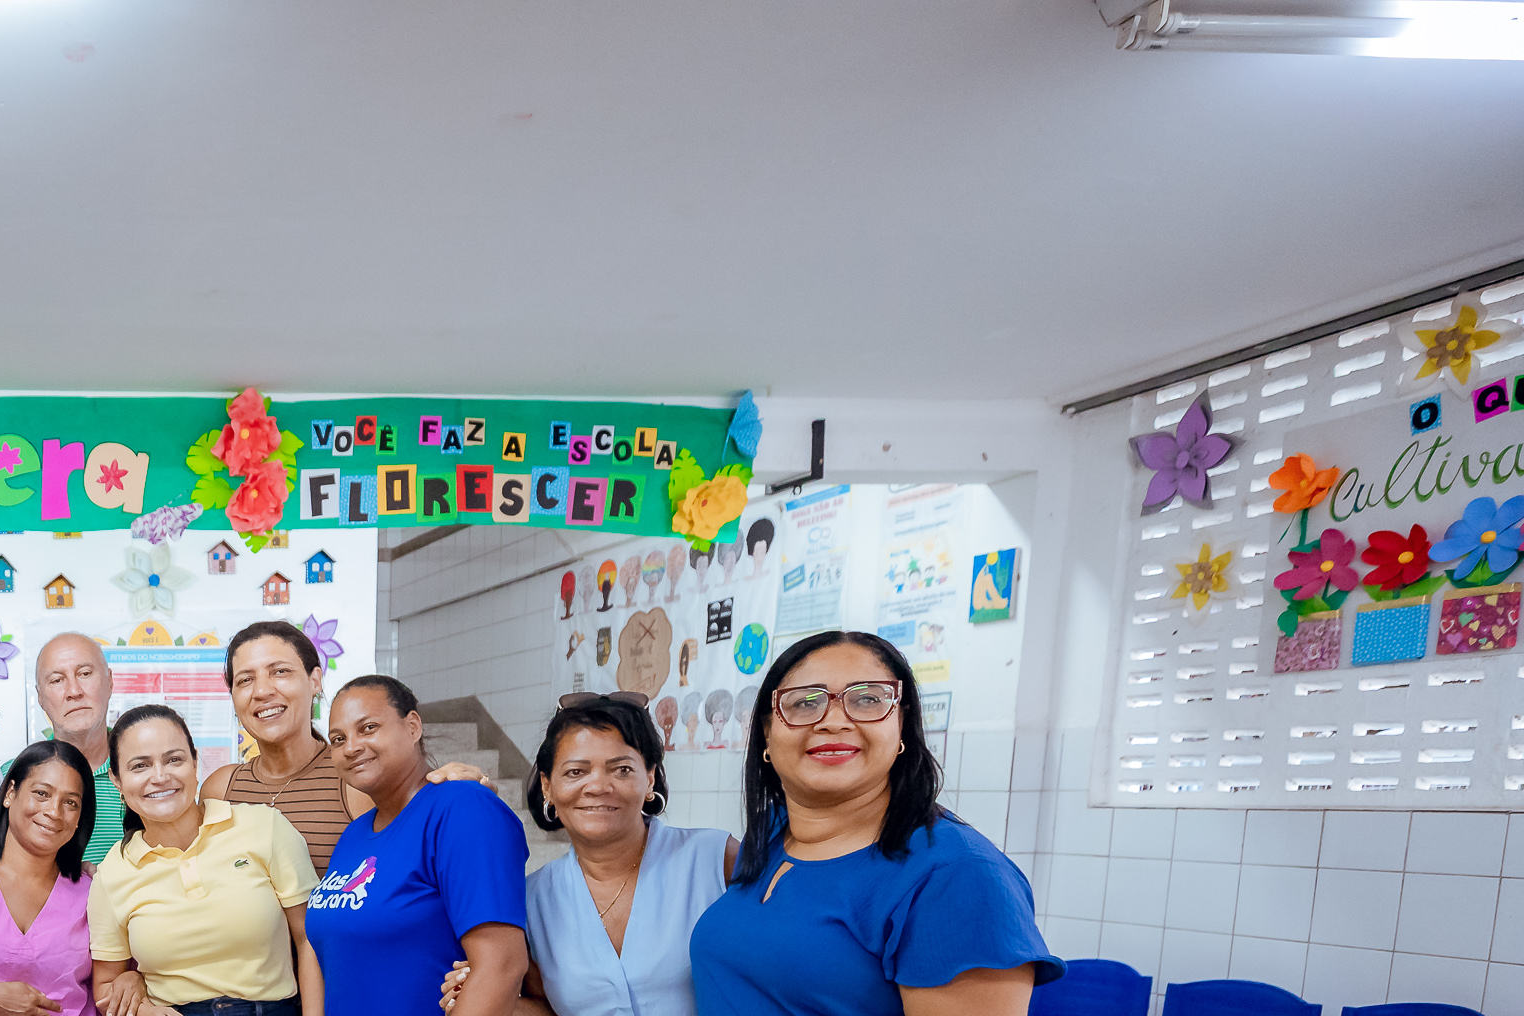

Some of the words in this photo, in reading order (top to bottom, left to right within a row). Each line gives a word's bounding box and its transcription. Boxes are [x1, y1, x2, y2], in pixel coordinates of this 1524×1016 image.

[1412, 402, 1439, 430] O
[313, 418, 394, 453] VOCÊ
[422, 420, 484, 451] FAZ
[504, 435, 522, 458] A
[553, 424, 674, 466] ESCOLA
[309, 469, 637, 521] FLORESCER
[110, 653, 137, 662] RITMOS
[138, 653, 148, 661] DO
